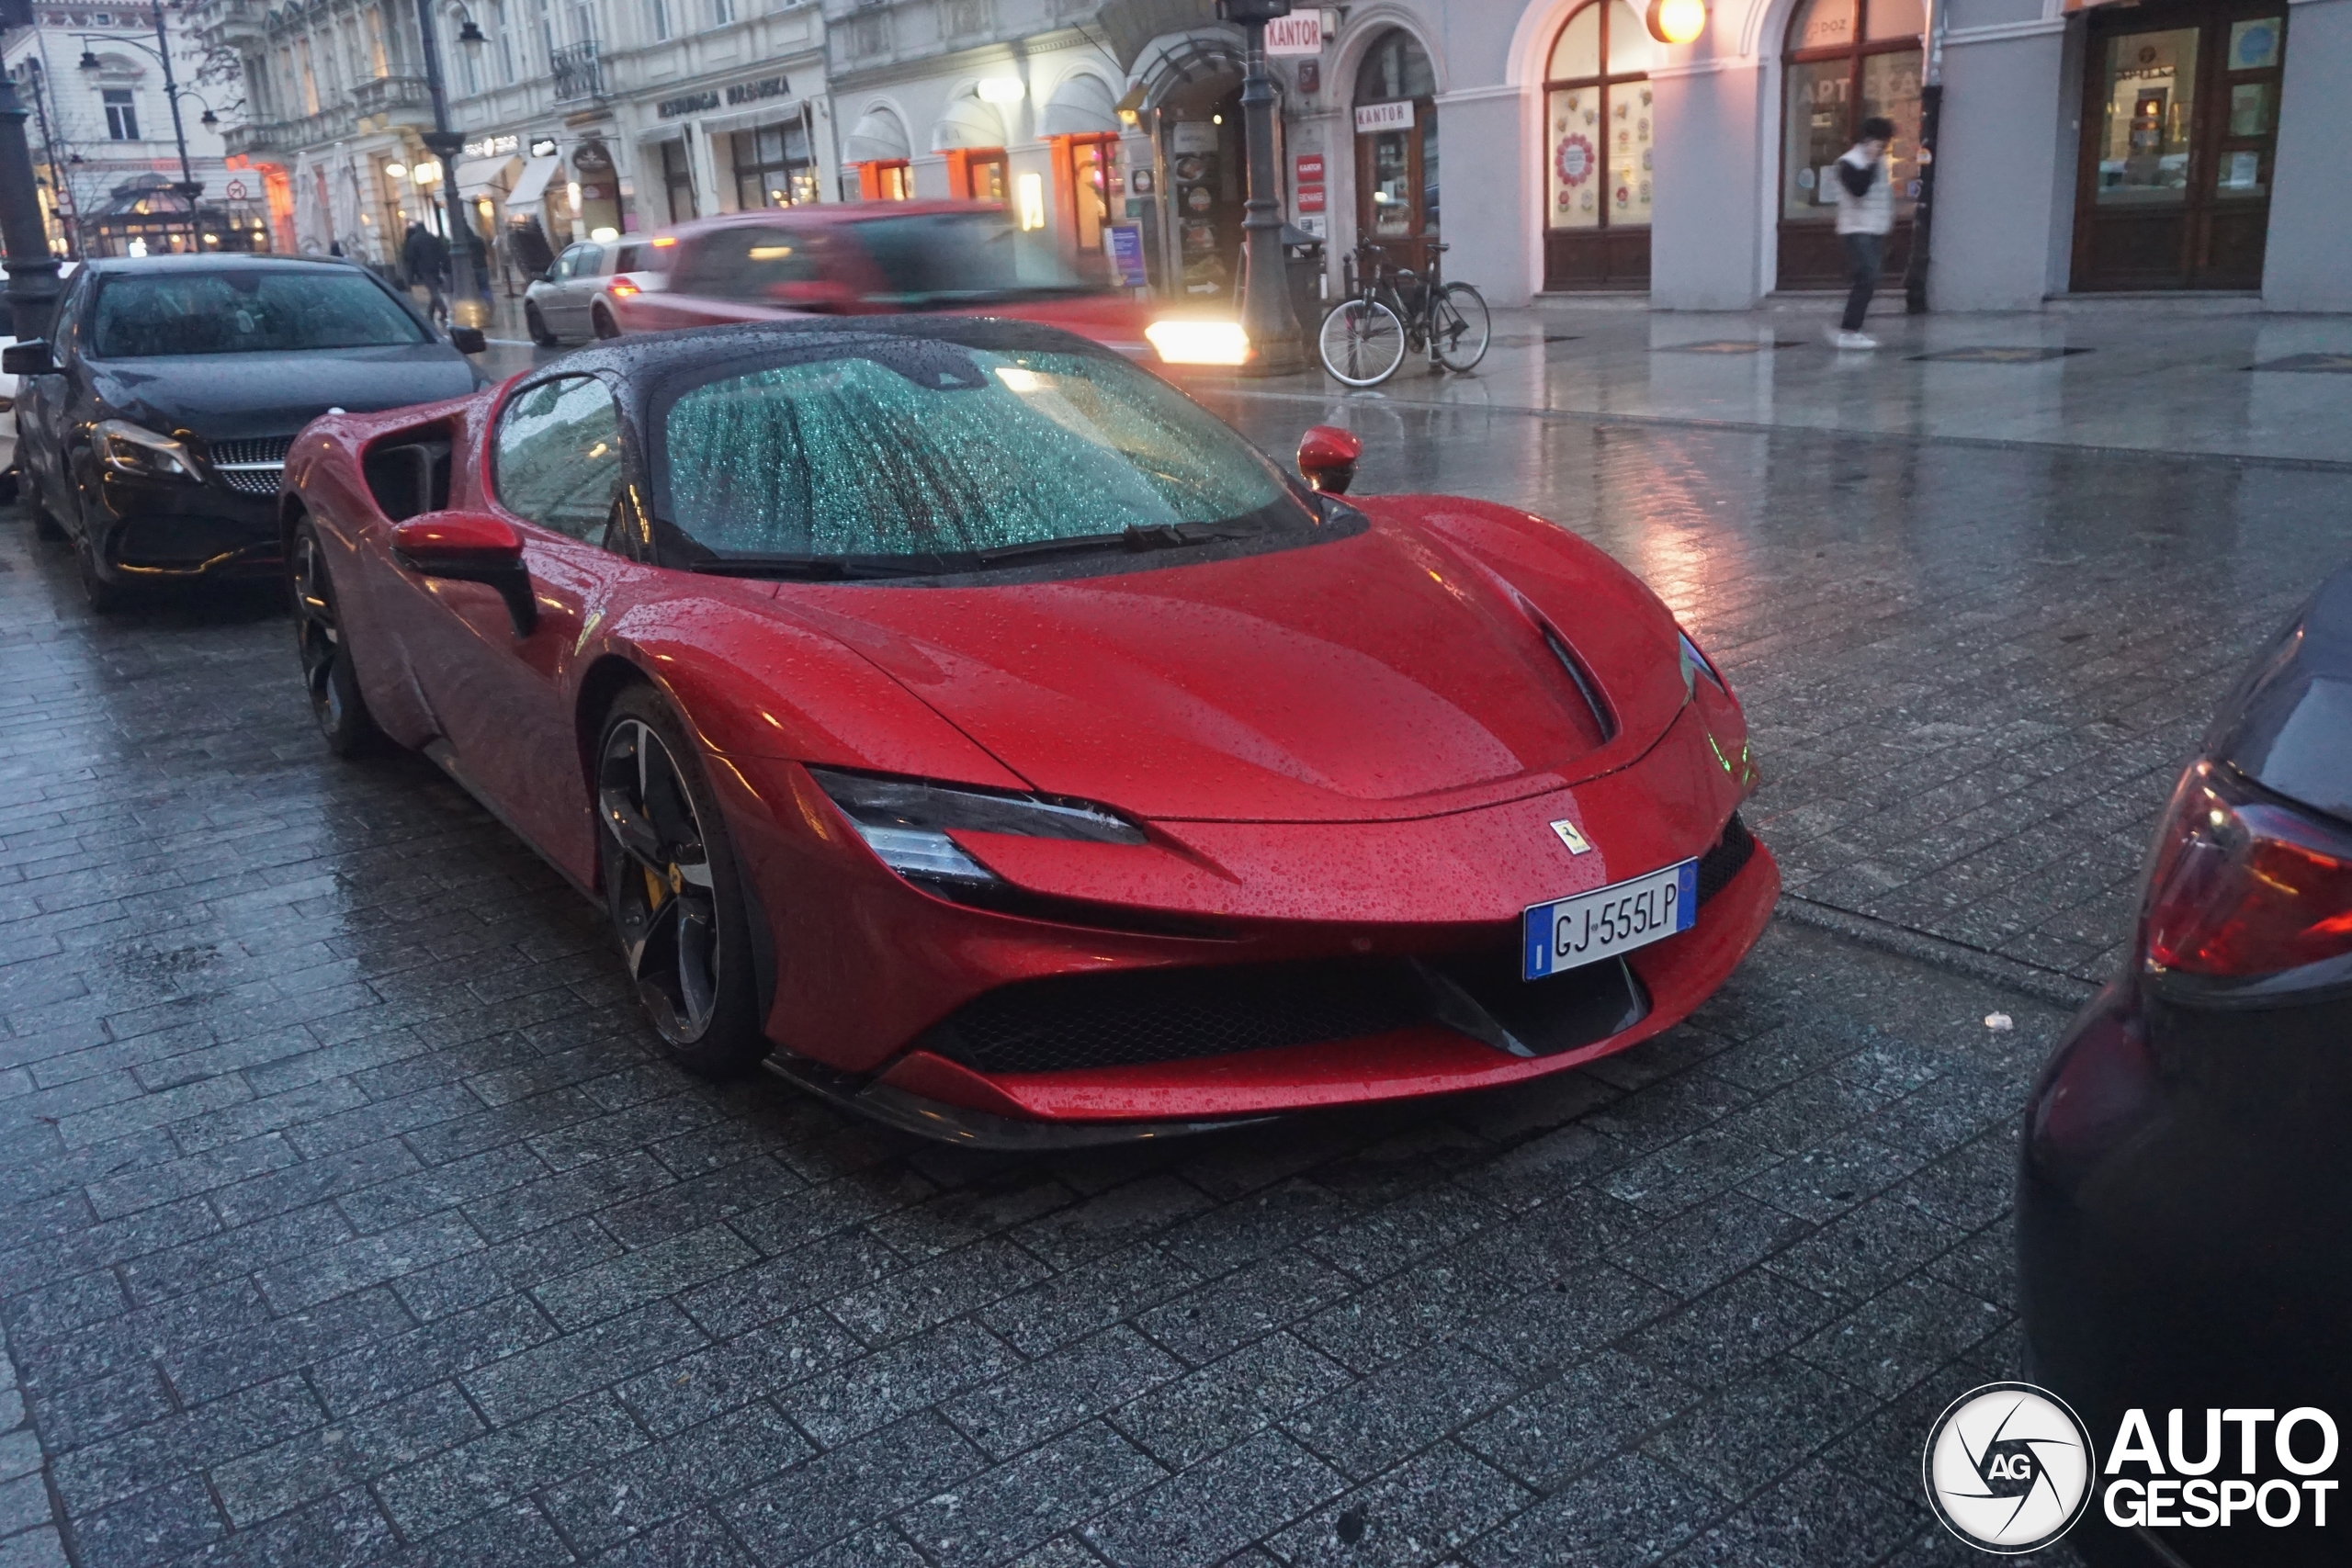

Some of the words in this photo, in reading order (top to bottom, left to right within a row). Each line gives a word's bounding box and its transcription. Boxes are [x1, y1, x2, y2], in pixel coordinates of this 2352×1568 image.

[1268, 18, 1320, 47] KANTOR
[1820, 18, 1848, 33] DOZ
[1357, 104, 1405, 126] KANTOR
[1298, 163, 1322, 173] KANTOR
